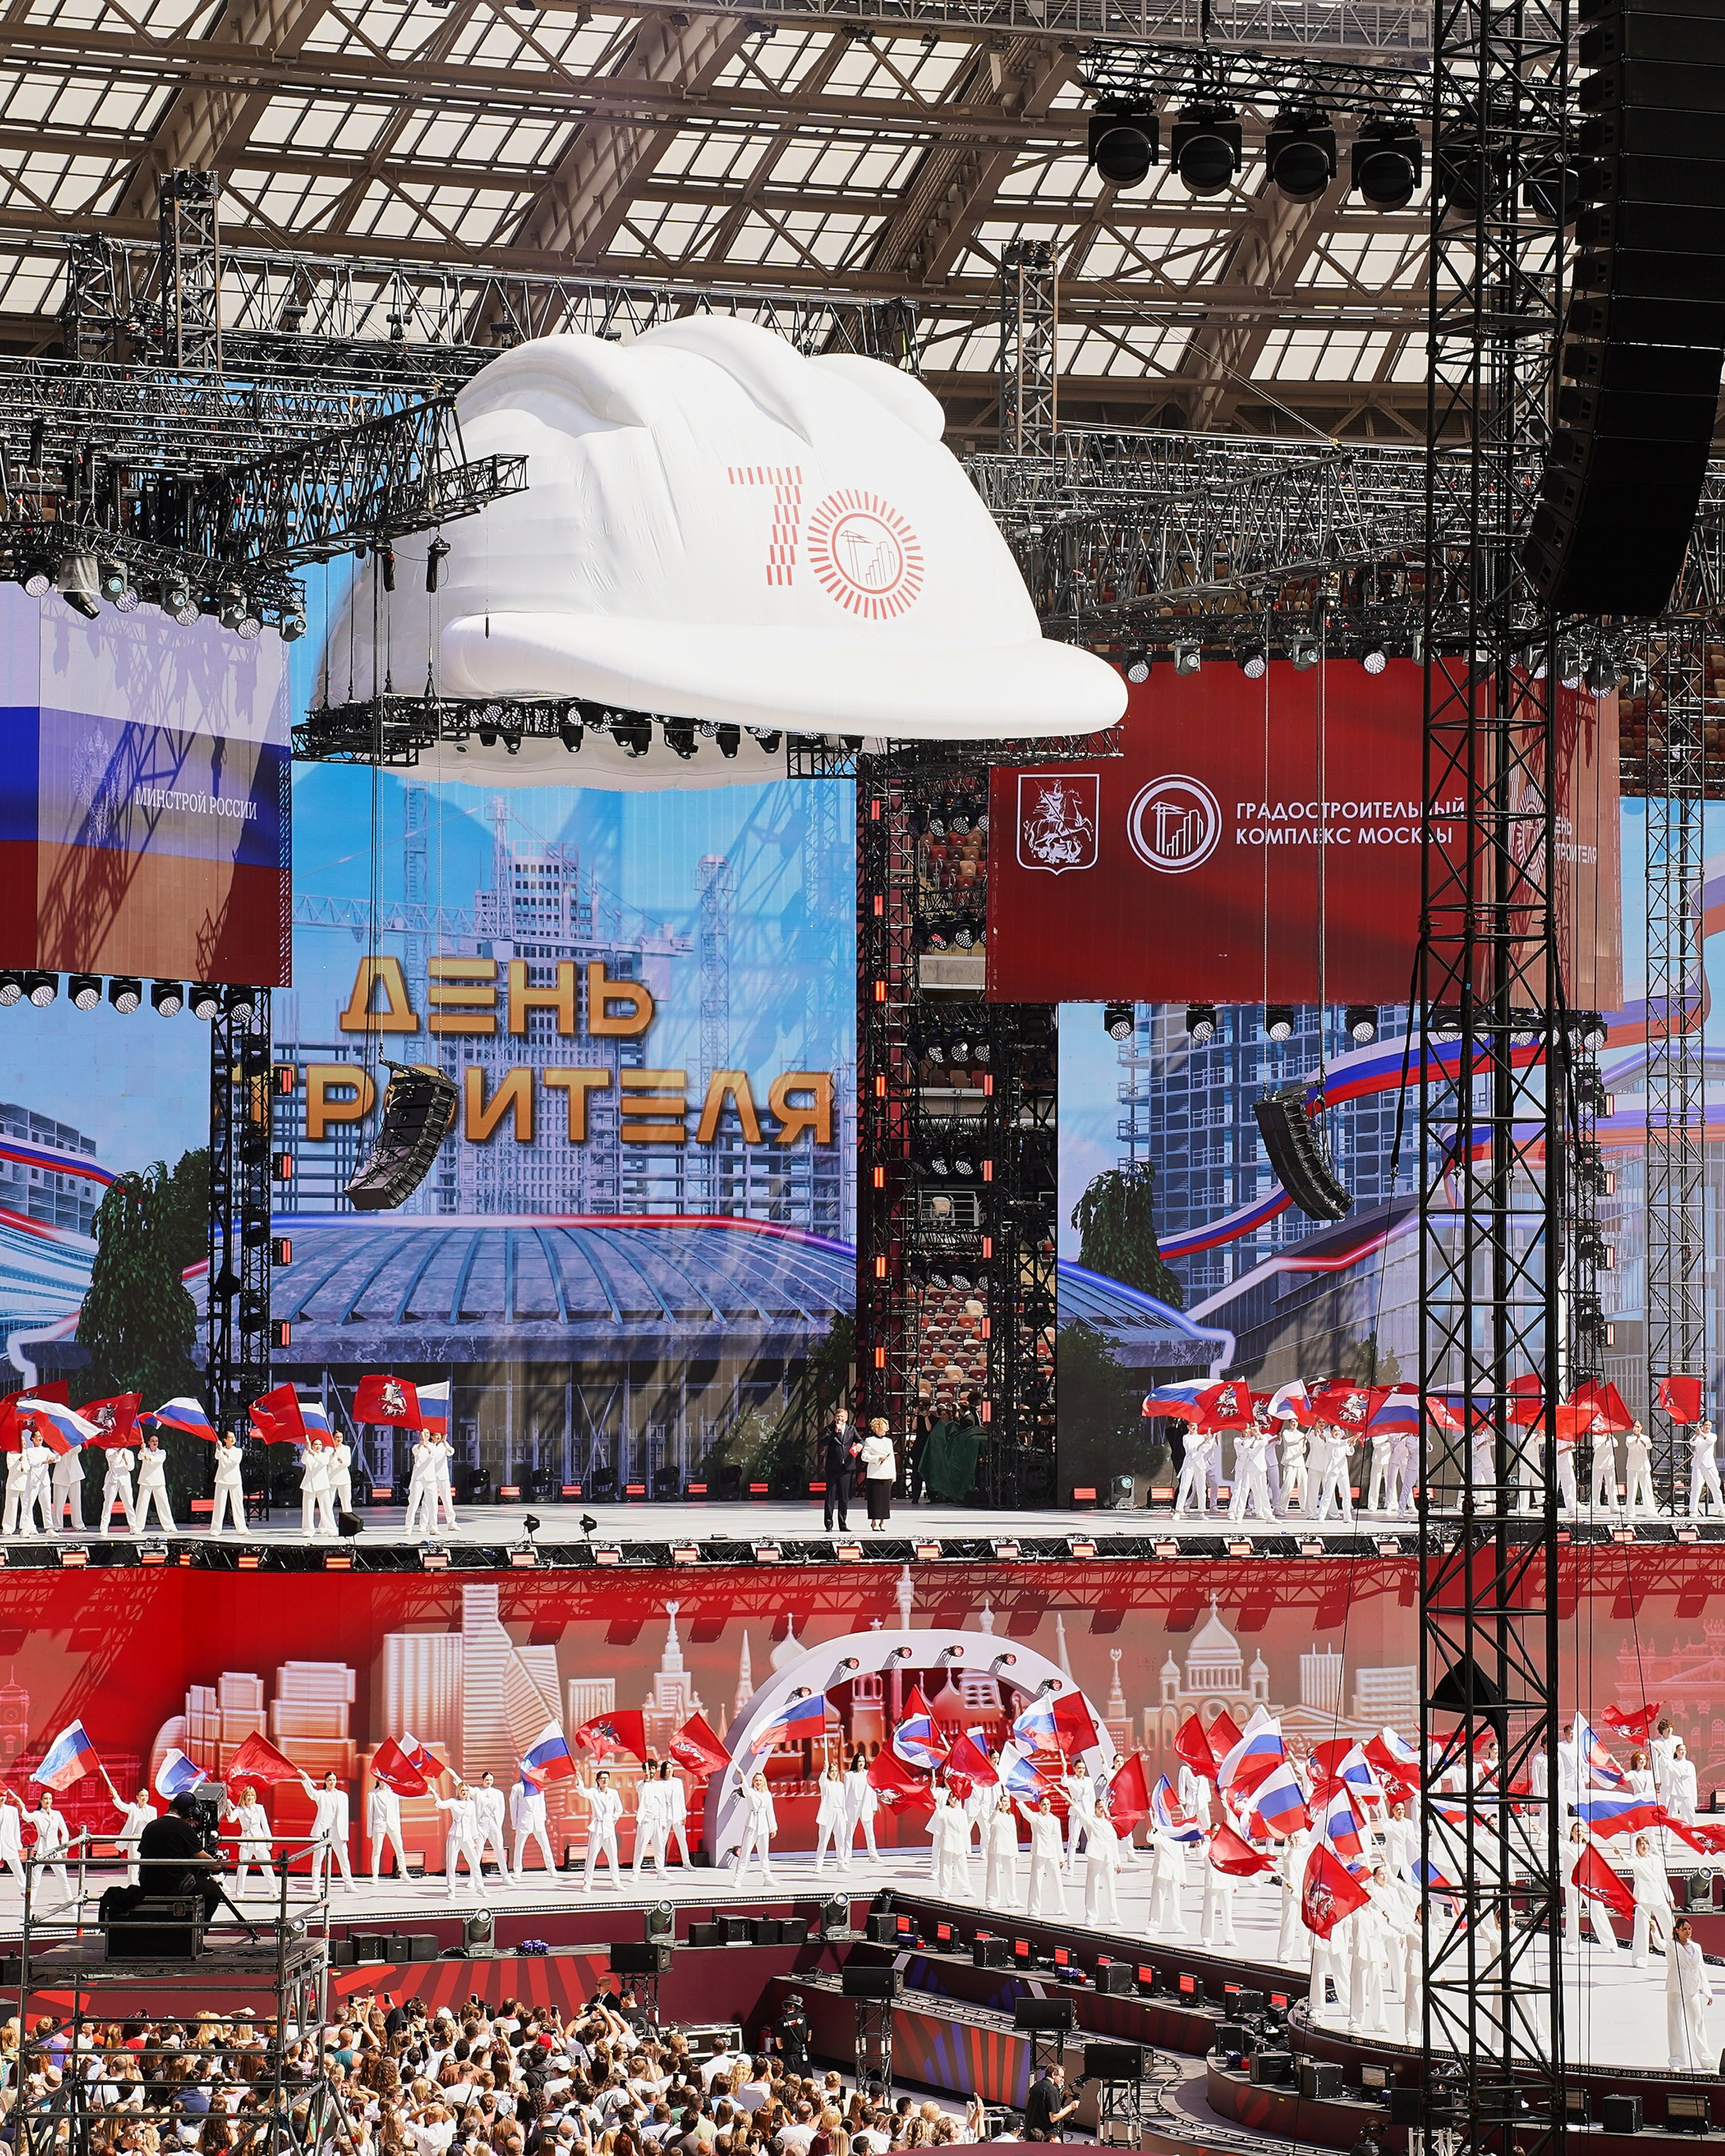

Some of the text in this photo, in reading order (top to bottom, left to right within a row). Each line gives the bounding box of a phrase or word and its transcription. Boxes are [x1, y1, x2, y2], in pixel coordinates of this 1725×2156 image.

[135, 786, 257, 821] МИНСТРОЙ РОССИИ
[1236, 827, 1352, 845] КОМПЛЕКС
[1554, 816, 1572, 835] ЕНЬ
[1554, 842, 1598, 864] ТРОИТЕЛЯ
[340, 955, 656, 1038] ДЕНЬ
